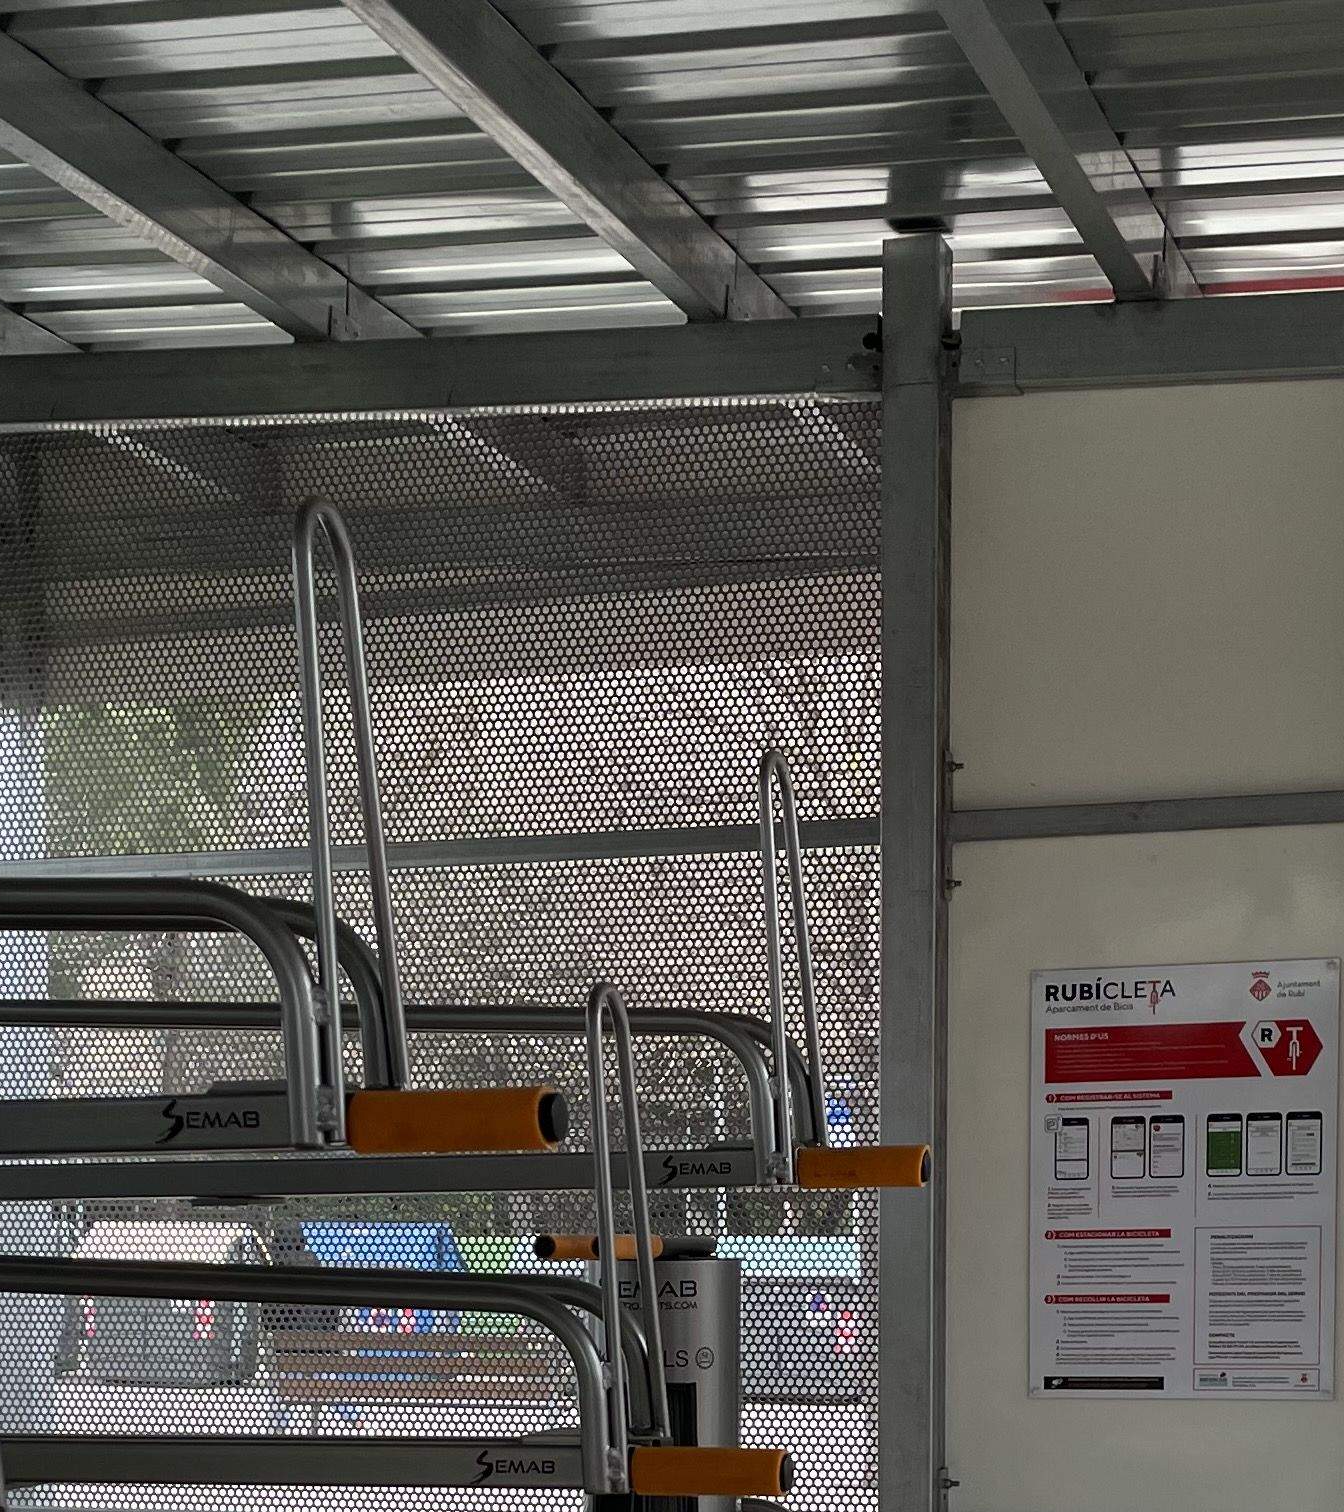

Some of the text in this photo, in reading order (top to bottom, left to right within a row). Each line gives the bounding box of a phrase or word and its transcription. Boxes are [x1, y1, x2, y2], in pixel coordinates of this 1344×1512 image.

[1260, 1027, 1274, 1042] R
[155, 1099, 260, 1144] SEMAB
[658, 1154, 732, 1186] SEMAB
[617, 1280, 697, 1298] EAB
[470, 1449, 556, 1486] SEMAB
